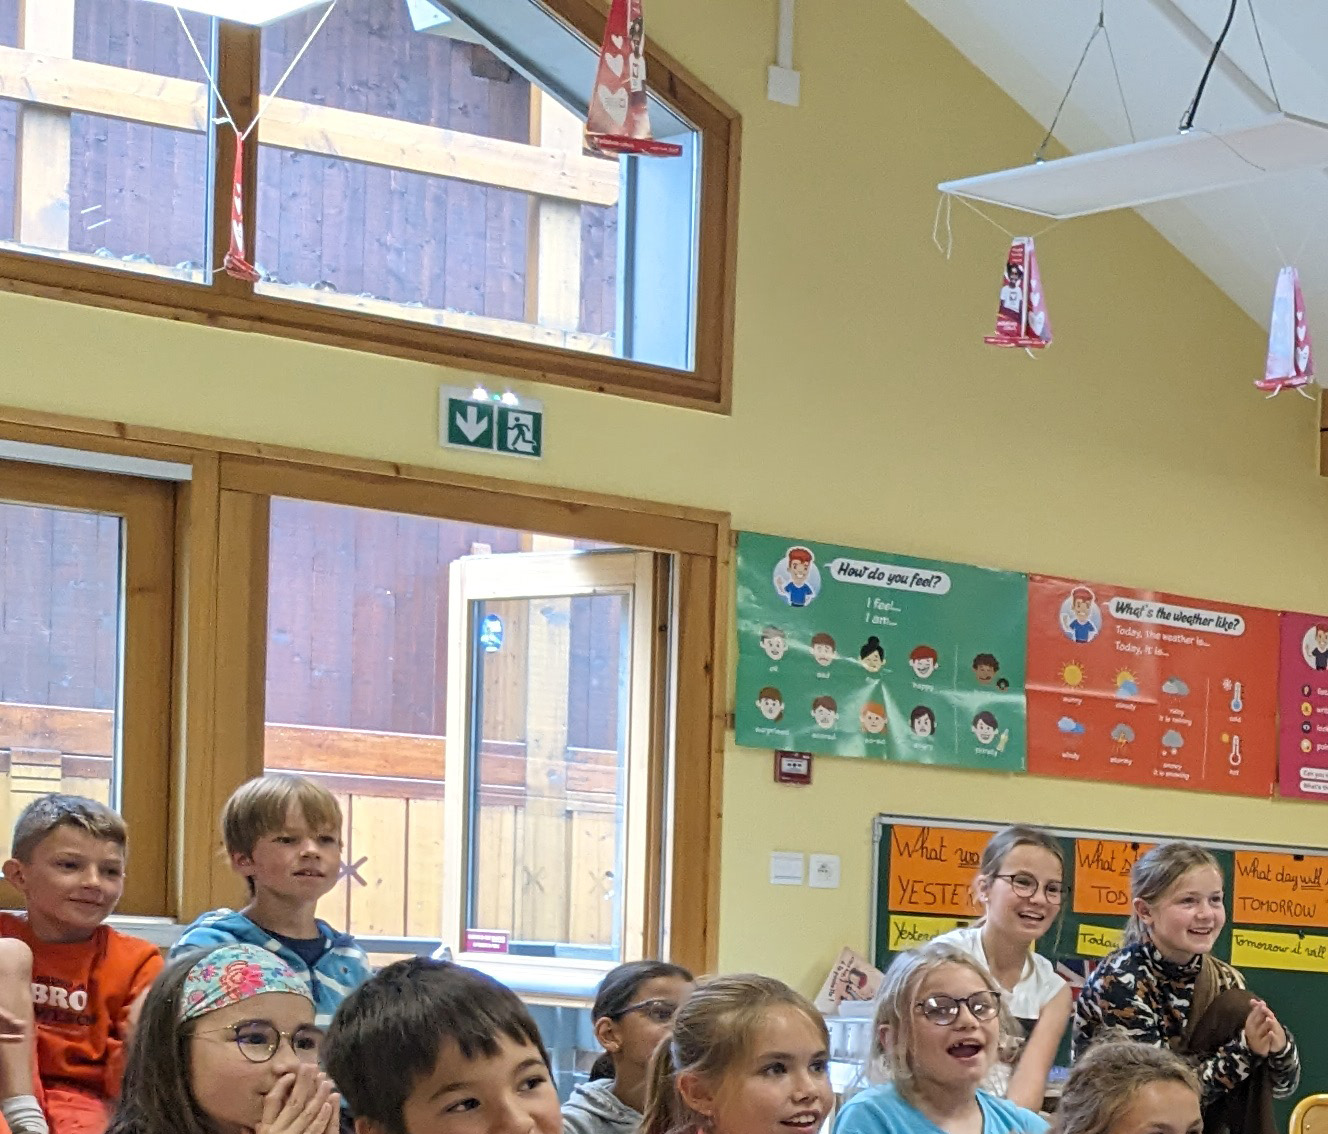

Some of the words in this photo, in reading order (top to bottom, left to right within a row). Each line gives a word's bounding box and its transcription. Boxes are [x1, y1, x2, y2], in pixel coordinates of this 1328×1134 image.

[838, 562, 868, 578] How
[868, 567, 885, 580] do
[886, 573, 908, 585] you
[909, 573, 942, 588] feel?
[1115, 601, 1154, 619] What's
[1156, 607, 1171, 621] the
[1173, 611, 1215, 627] weather
[1215, 616, 1240, 632] like?
[892, 826, 947, 862] What
[1236, 857, 1272, 881] What
[1275, 866, 1299, 891] day
[1300, 867, 1323, 888] will
[1091, 885, 1130, 906] TOD
[1238, 896, 1317, 918] TOMORROW
[1233, 934, 1289, 952] Tomorrow
